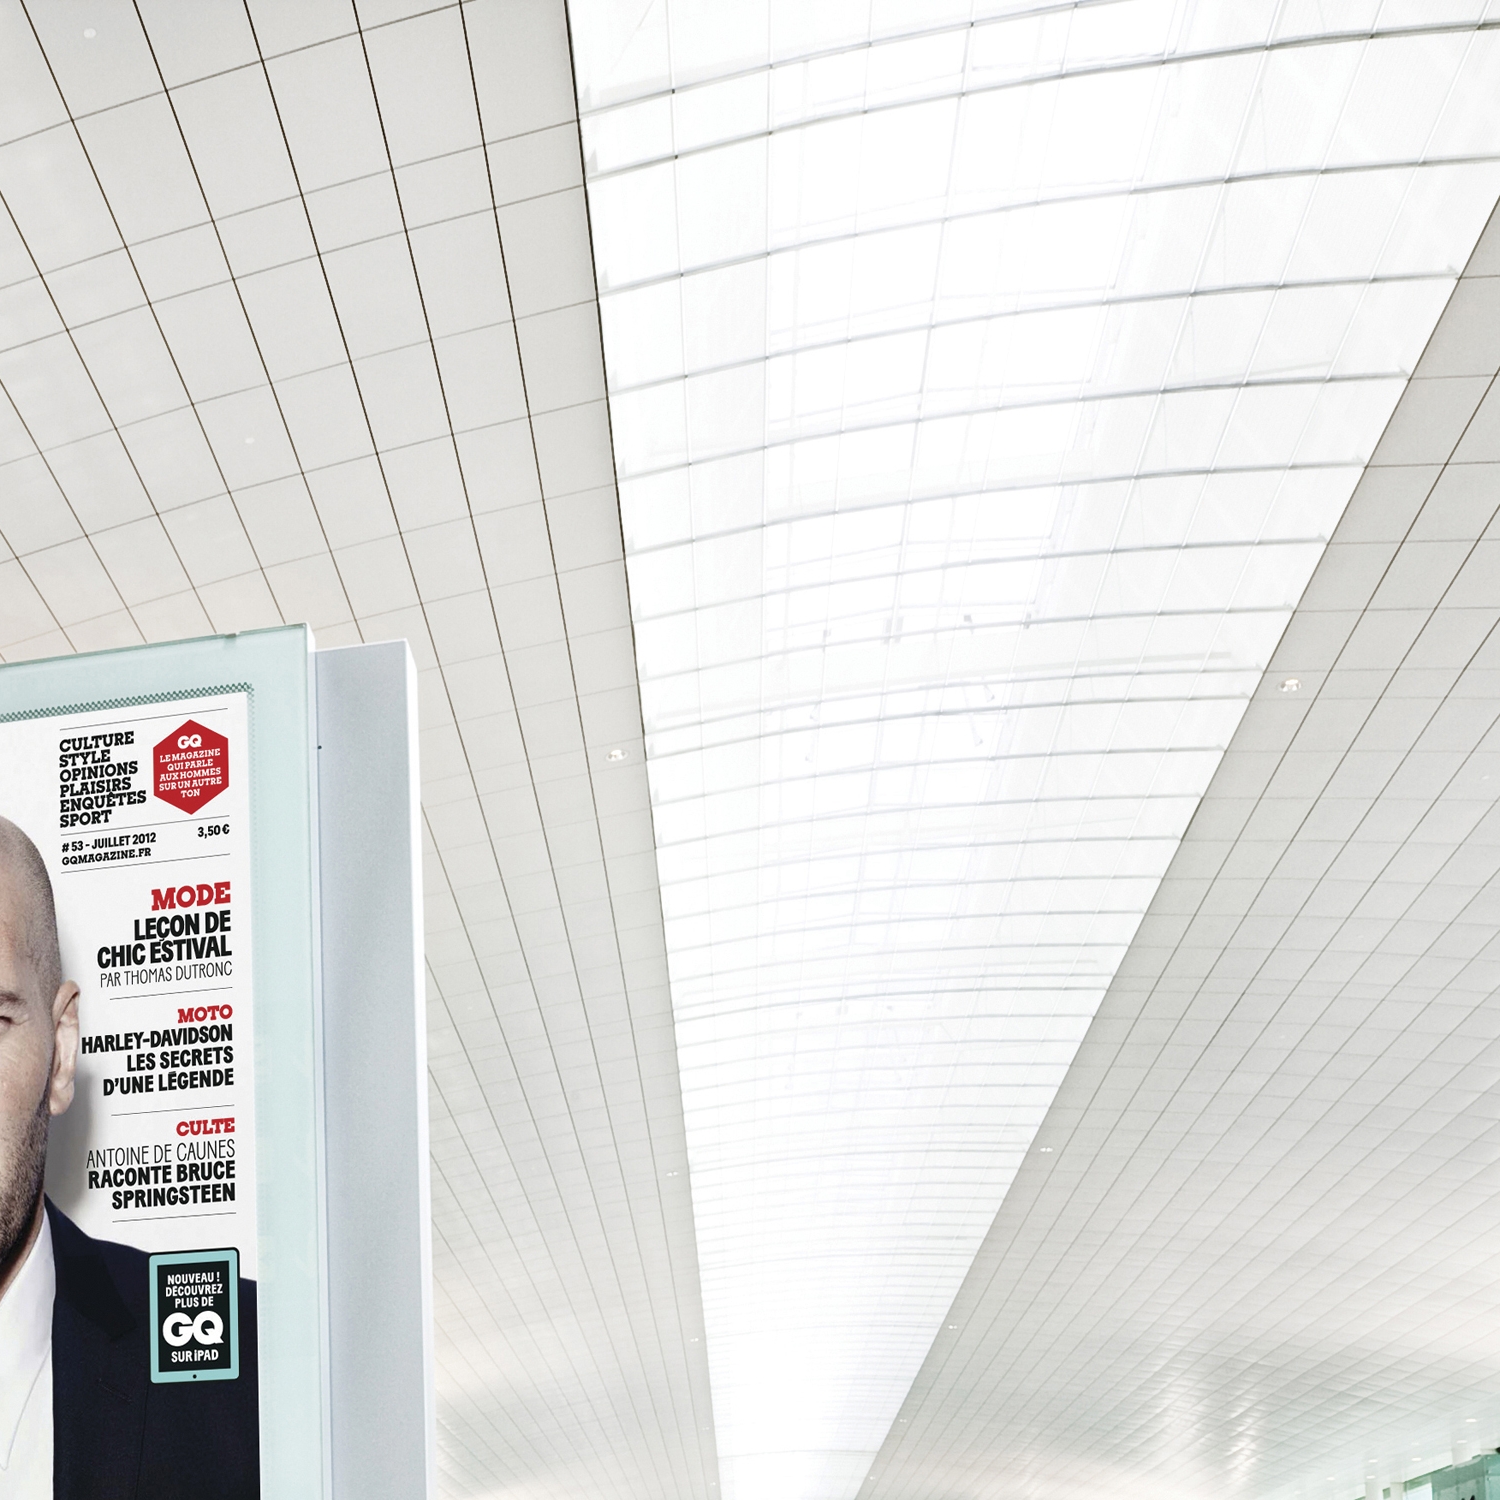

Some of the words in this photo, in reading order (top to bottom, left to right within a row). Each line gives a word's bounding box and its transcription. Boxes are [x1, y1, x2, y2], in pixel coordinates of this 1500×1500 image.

[59, 731, 134, 753] CULTURE
[177, 734, 202, 749] GQ
[59, 749, 111, 768] STYLE
[160, 754, 171, 763] LE
[172, 748, 221, 761] MAGAZINE
[167, 761, 183, 771] QUI
[185, 759, 213, 769] PARLE
[60, 761, 138, 782] OPINIONS
[159, 772, 179, 782] AUX
[180, 767, 221, 779] HOMMES
[60, 777, 131, 798] PLAISIRS
[159, 781, 177, 791] SUR
[178, 780, 191, 789] UN
[192, 776, 222, 787] AUTRE
[181, 789, 200, 798] TON
[60, 790, 146, 813] ENQUÊTES
[60, 809, 112, 829] SPORT
[71, 841, 84, 852] 53
[92, 835, 131, 849] JUILLET
[132, 832, 157, 845] 2012
[62, 847, 151, 866] GQMAGAZINE.FR
[151, 881, 231, 911] MODE
[134, 913, 200, 942] LEÇON
[205, 910, 231, 933] DE
[97, 943, 146, 969] CHIC
[150, 935, 232, 964] ESTIVAL
[100, 971, 121, 988] PAR
[124, 966, 172, 985] THOMAS
[176, 960, 233, 981] DUTRONC
[177, 1004, 233, 1023] MOTO
[82, 1024, 233, 1054] HARLEY-DAVIDSON
[127, 1053, 156, 1072] LES
[159, 1045, 234, 1069] SECRETS
[159, 1069, 234, 1091] LÉGENDE
[176, 1117, 235, 1137] CULTE
[86, 1145, 149, 1169] ANTOINE
[154, 1144, 172, 1164] DE
[176, 1138, 235, 1162] CAUNES
[88, 1165, 172, 1189] RACONTE
[176, 1160, 235, 1183] BRUCE
[112, 1182, 235, 1210] SPRINGSTEEN
[167, 1272, 215, 1285] NOUVEAU
[175, 1297, 199, 1309] PLUS
[201, 1296, 214, 1307] DE
[162, 1310, 225, 1347] GQ
[171, 1350, 193, 1363] SUR
[193, 1349, 219, 1362] iPAD
